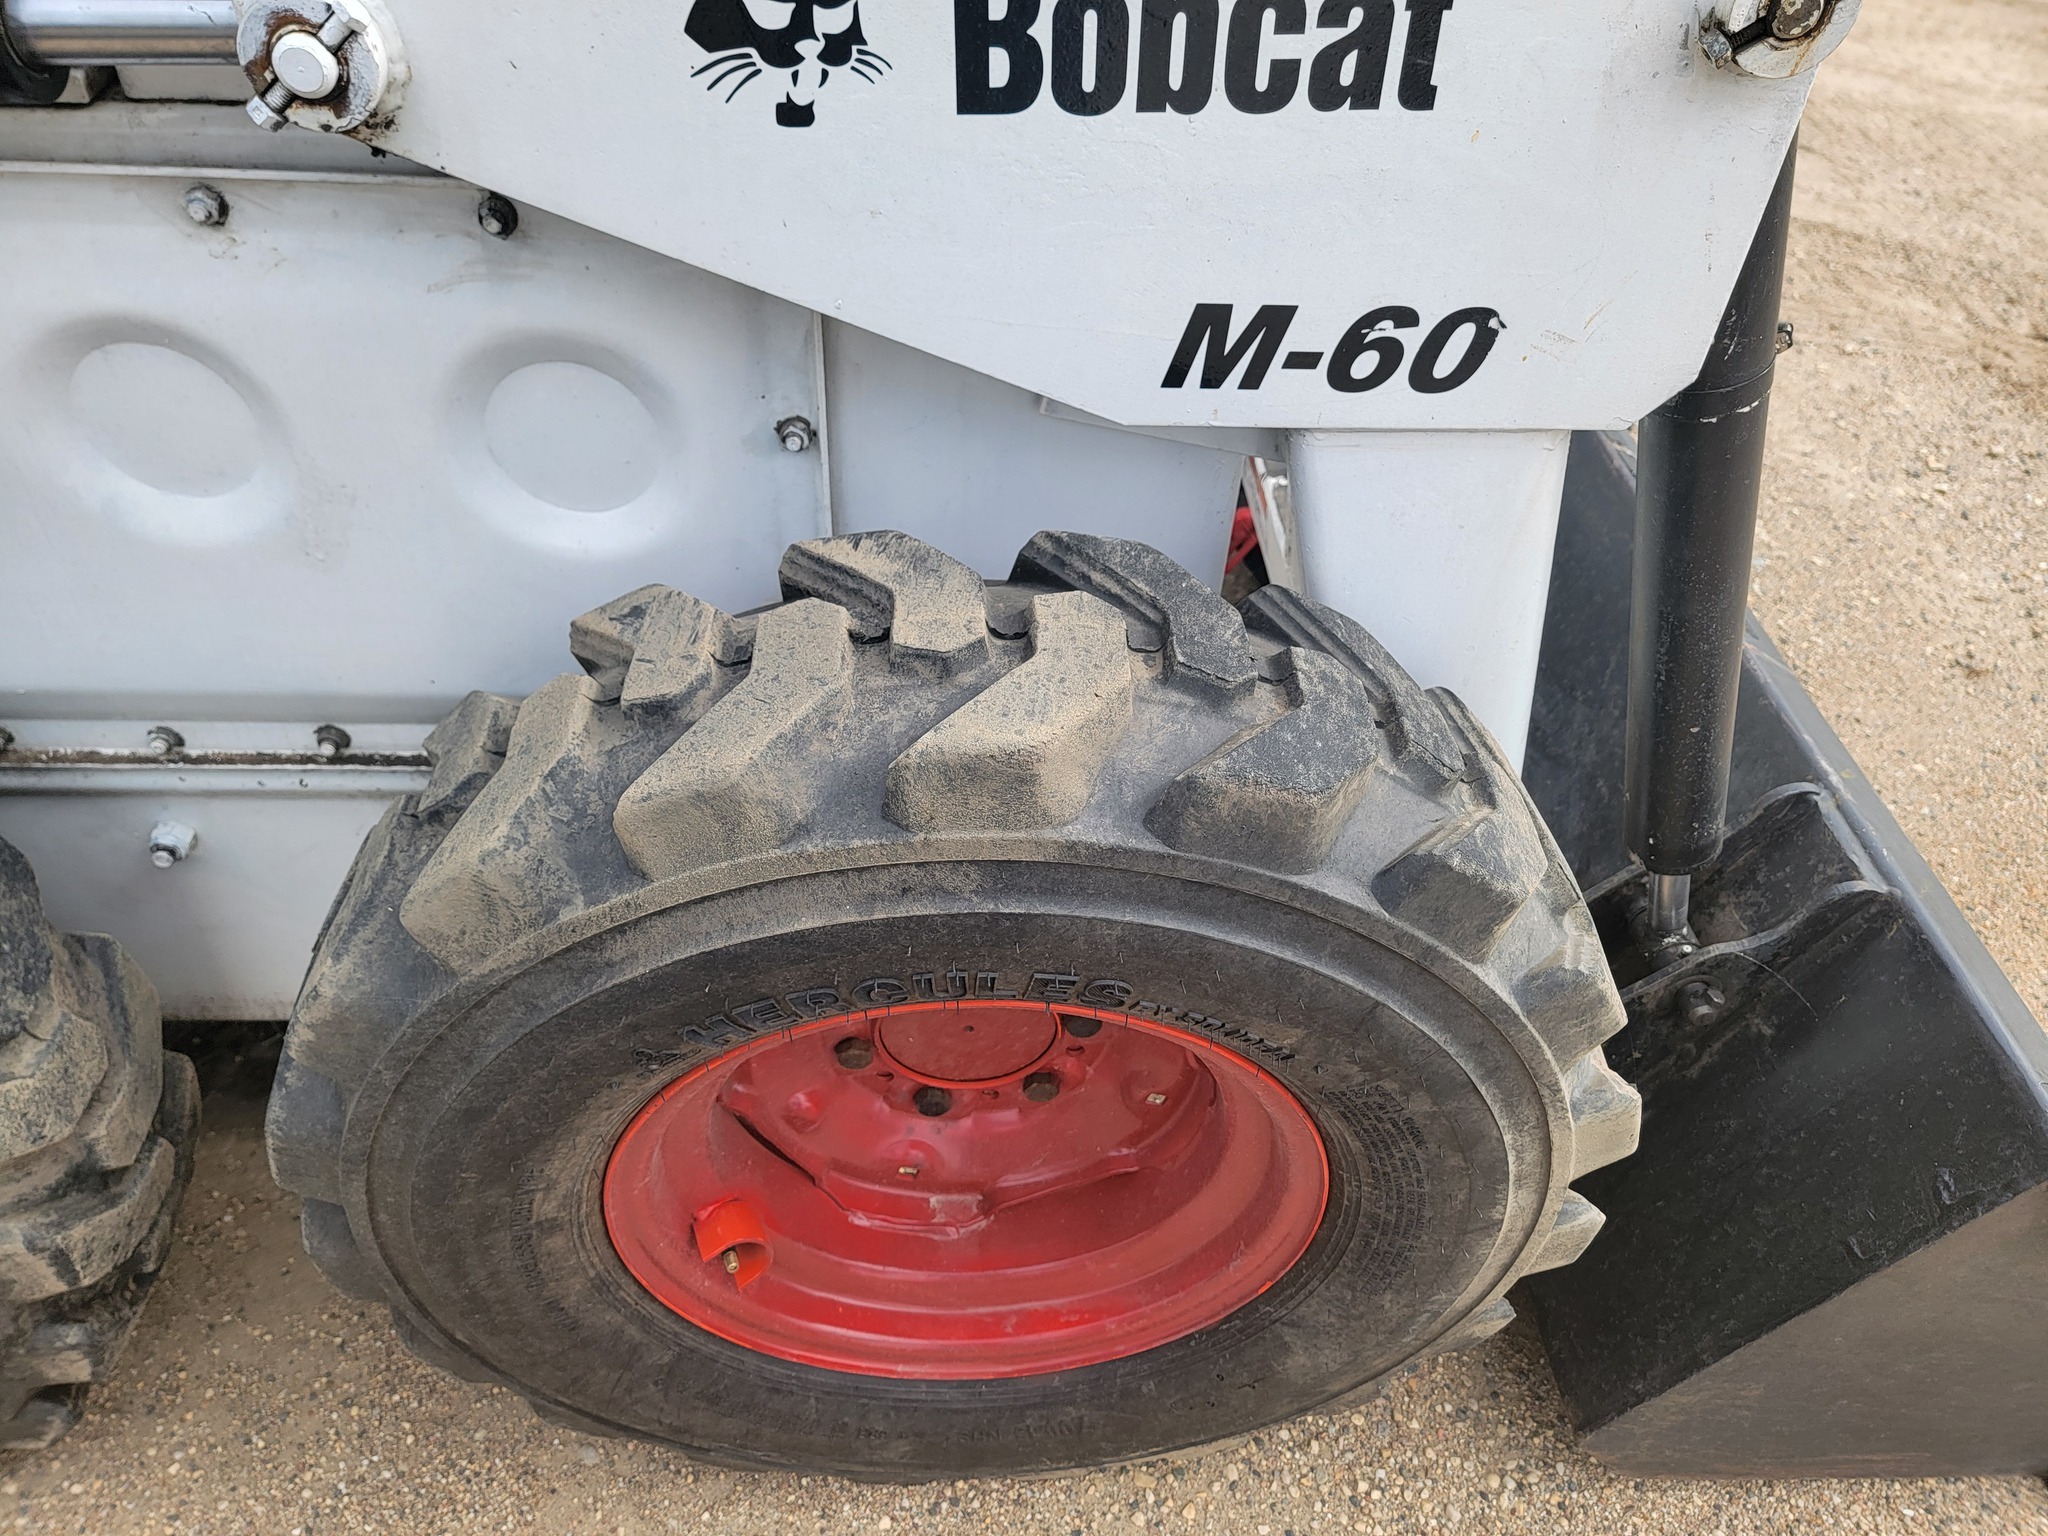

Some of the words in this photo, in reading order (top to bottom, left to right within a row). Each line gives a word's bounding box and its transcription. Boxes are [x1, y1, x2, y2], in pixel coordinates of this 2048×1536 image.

[955, 0, 1452, 116] Bobcat
[1160, 303, 1507, 394] M-60
[682, 970, 1134, 1051] HERCULES
